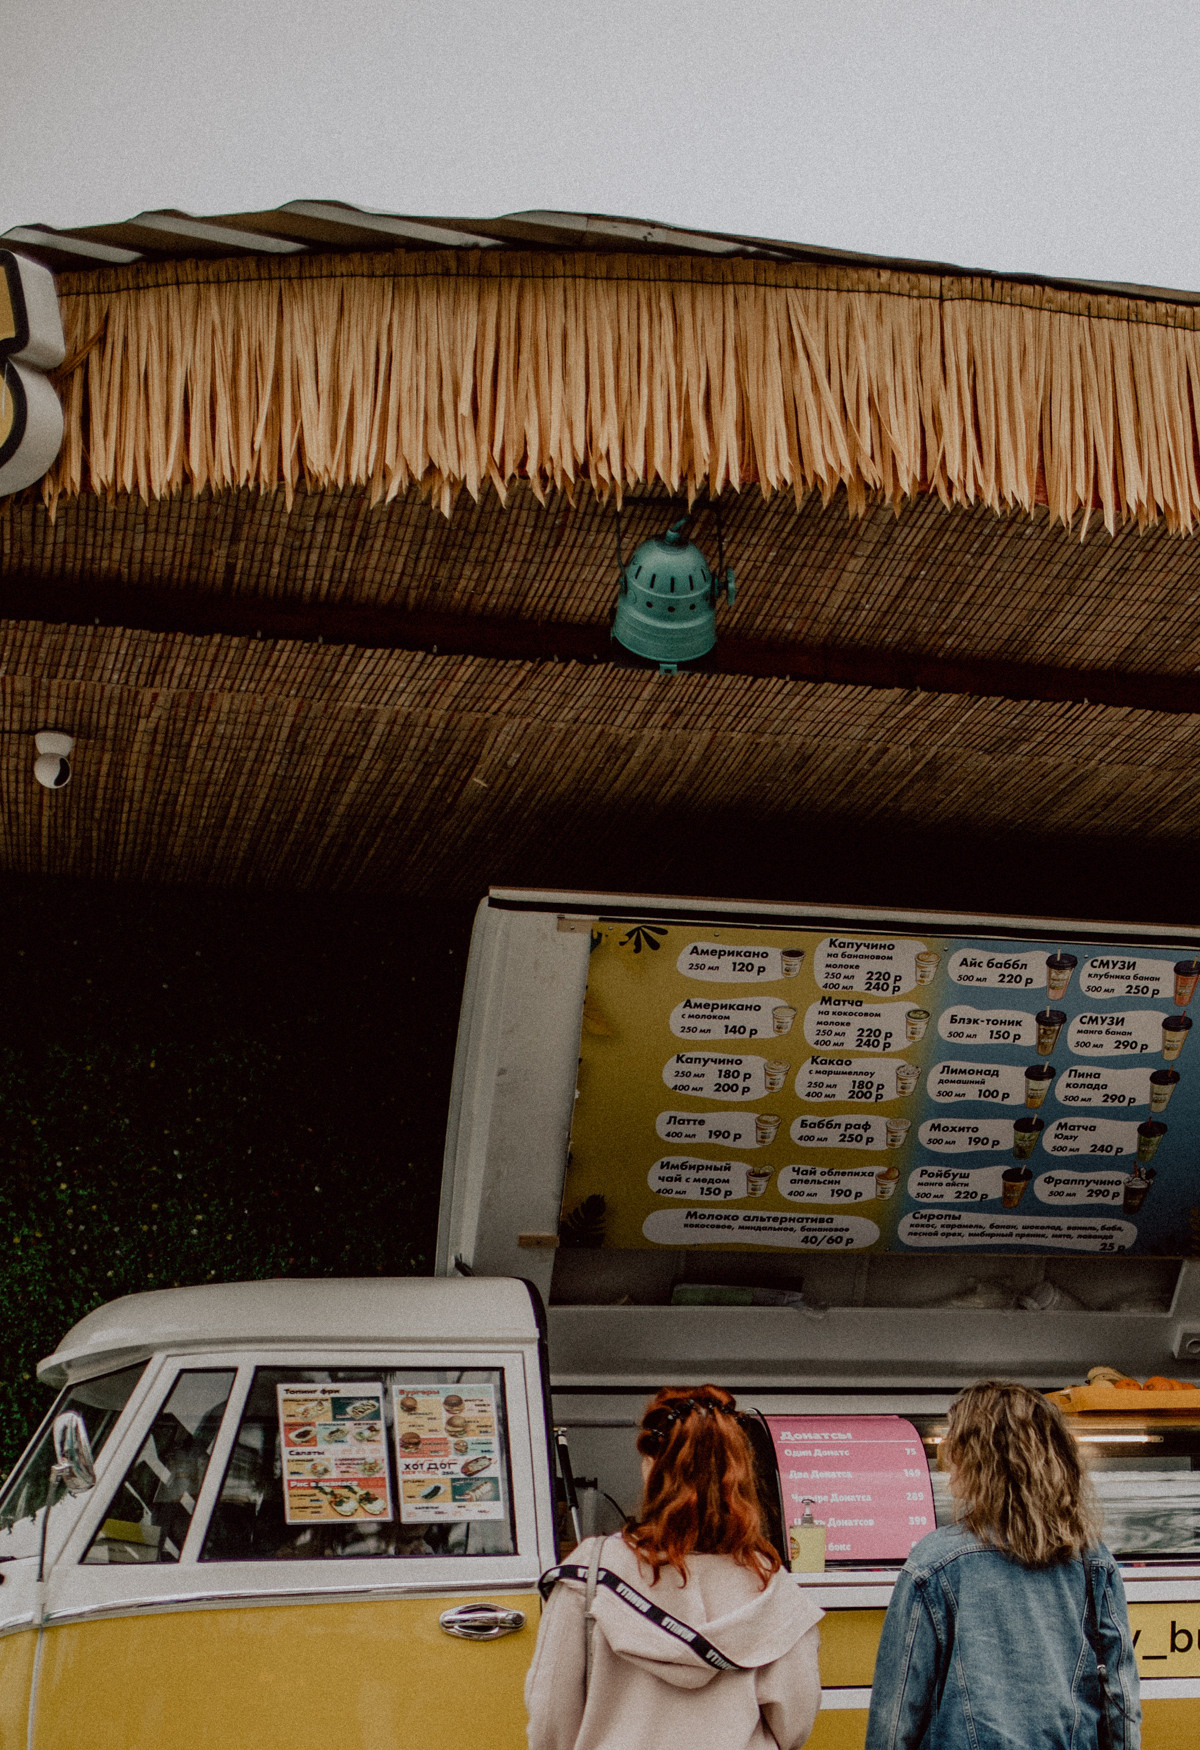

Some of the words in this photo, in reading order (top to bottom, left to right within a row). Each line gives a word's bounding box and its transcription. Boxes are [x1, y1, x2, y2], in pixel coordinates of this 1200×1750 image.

[828, 938, 896, 953] Капучино
[689, 945, 770, 960] Американо
[840, 951, 894, 961] банановом
[688, 962, 707, 971] 250
[732, 961, 755, 973] 120
[756, 965, 767, 976] р
[958, 957, 984, 969] Айс
[986, 957, 1028, 970] баббл
[1090, 958, 1137, 971] СМУЗИ
[824, 971, 842, 980] 250
[866, 970, 892, 982] 220
[893, 974, 903, 985] р
[957, 974, 975, 982] 500
[997, 973, 1023, 984] 220
[1024, 977, 1034, 988] р
[1087, 971, 1131, 981] клубника
[1132, 973, 1161, 982] банан
[1085, 985, 1103, 993] 500
[1125, 984, 1150, 995] 250
[1150, 988, 1160, 999] р
[682, 998, 762, 1013] Американо
[820, 995, 864, 1007] Матча
[687, 1013, 731, 1021] молоком
[831, 1010, 882, 1018] кокосовом
[949, 1014, 1023, 1027] Блэк-тоник
[1079, 1015, 1126, 1027] СМУЗИ
[680, 1025, 698, 1034] 250
[724, 1024, 747, 1035] 140
[748, 1028, 758, 1039] р
[815, 1028, 833, 1037] 250
[857, 1027, 882, 1039] 220
[883, 1031, 893, 1042] р
[947, 1031, 965, 1039] 500
[989, 1029, 1011, 1041] 150
[1012, 1033, 1022, 1044] р
[1104, 1028, 1133, 1036] банан
[1074, 1040, 1092, 1049] 500
[1113, 1039, 1139, 1050] 290
[1139, 1043, 1149, 1054] р
[675, 1053, 743, 1068] Капучино
[810, 1055, 853, 1067] Какао
[674, 1070, 692, 1079] 250
[717, 1068, 741, 1080] 180
[742, 1072, 752, 1083] р
[814, 1069, 876, 1079] маршмеллоу
[939, 1064, 1000, 1078] Лимонад
[1067, 1068, 1102, 1080] Пина
[807, 1081, 825, 1089] 250
[852, 1079, 874, 1090] 180
[875, 1083, 885, 1093] р
[1065, 1082, 1109, 1091] колада
[935, 1090, 954, 1098] 500
[978, 1088, 1000, 1099] 100
[1001, 1092, 1011, 1102] р
[1101, 1093, 1127, 1104] 290
[1127, 1096, 1137, 1108] р
[665, 1115, 706, 1127] Латте
[799, 1118, 842, 1130] Баббл
[843, 1120, 872, 1133] раф
[1055, 1121, 1097, 1132] Матча
[929, 1122, 980, 1134] Мохито
[664, 1131, 684, 1139] 400
[708, 1129, 731, 1140] 190
[732, 1132, 743, 1143] р
[797, 1134, 816, 1142] 400
[838, 1132, 864, 1144] 250
[865, 1136, 875, 1146] р
[926, 1137, 944, 1146] 500
[968, 1136, 990, 1146] 190
[990, 1139, 1001, 1149] р
[659, 1160, 732, 1174] Имбирный
[791, 1166, 817, 1176] Чай
[819, 1167, 875, 1178] облепиха
[657, 1173, 683, 1183] чай
[692, 1177, 731, 1185] медом
[789, 1178, 841, 1186] апельсин
[919, 1169, 970, 1183] Ройбуш
[1043, 1175, 1123, 1188] Фраппучино
[787, 1190, 806, 1198] 400
[830, 1188, 853, 1198] 190
[853, 1191, 863, 1201] р
[684, 1210, 740, 1222] Молоко
[742, 1210, 836, 1226] альтернатива
[912, 1211, 962, 1223] Сиропы
[800, 1234, 844, 1247] 40/60
[844, 1237, 855, 1247] р
[1099, 1242, 1115, 1251] 25
[1115, 1244, 1126, 1254] р
[780, 1431, 853, 1441] Донатсы
[784, 1449, 812, 1457] Один
[813, 1449, 850, 1458] Донатс
[904, 1448, 917, 1456] 75
[830, 1493, 872, 1503] Донатса
[906, 1492, 925, 1502] 289
[908, 1516, 927, 1526] 399
